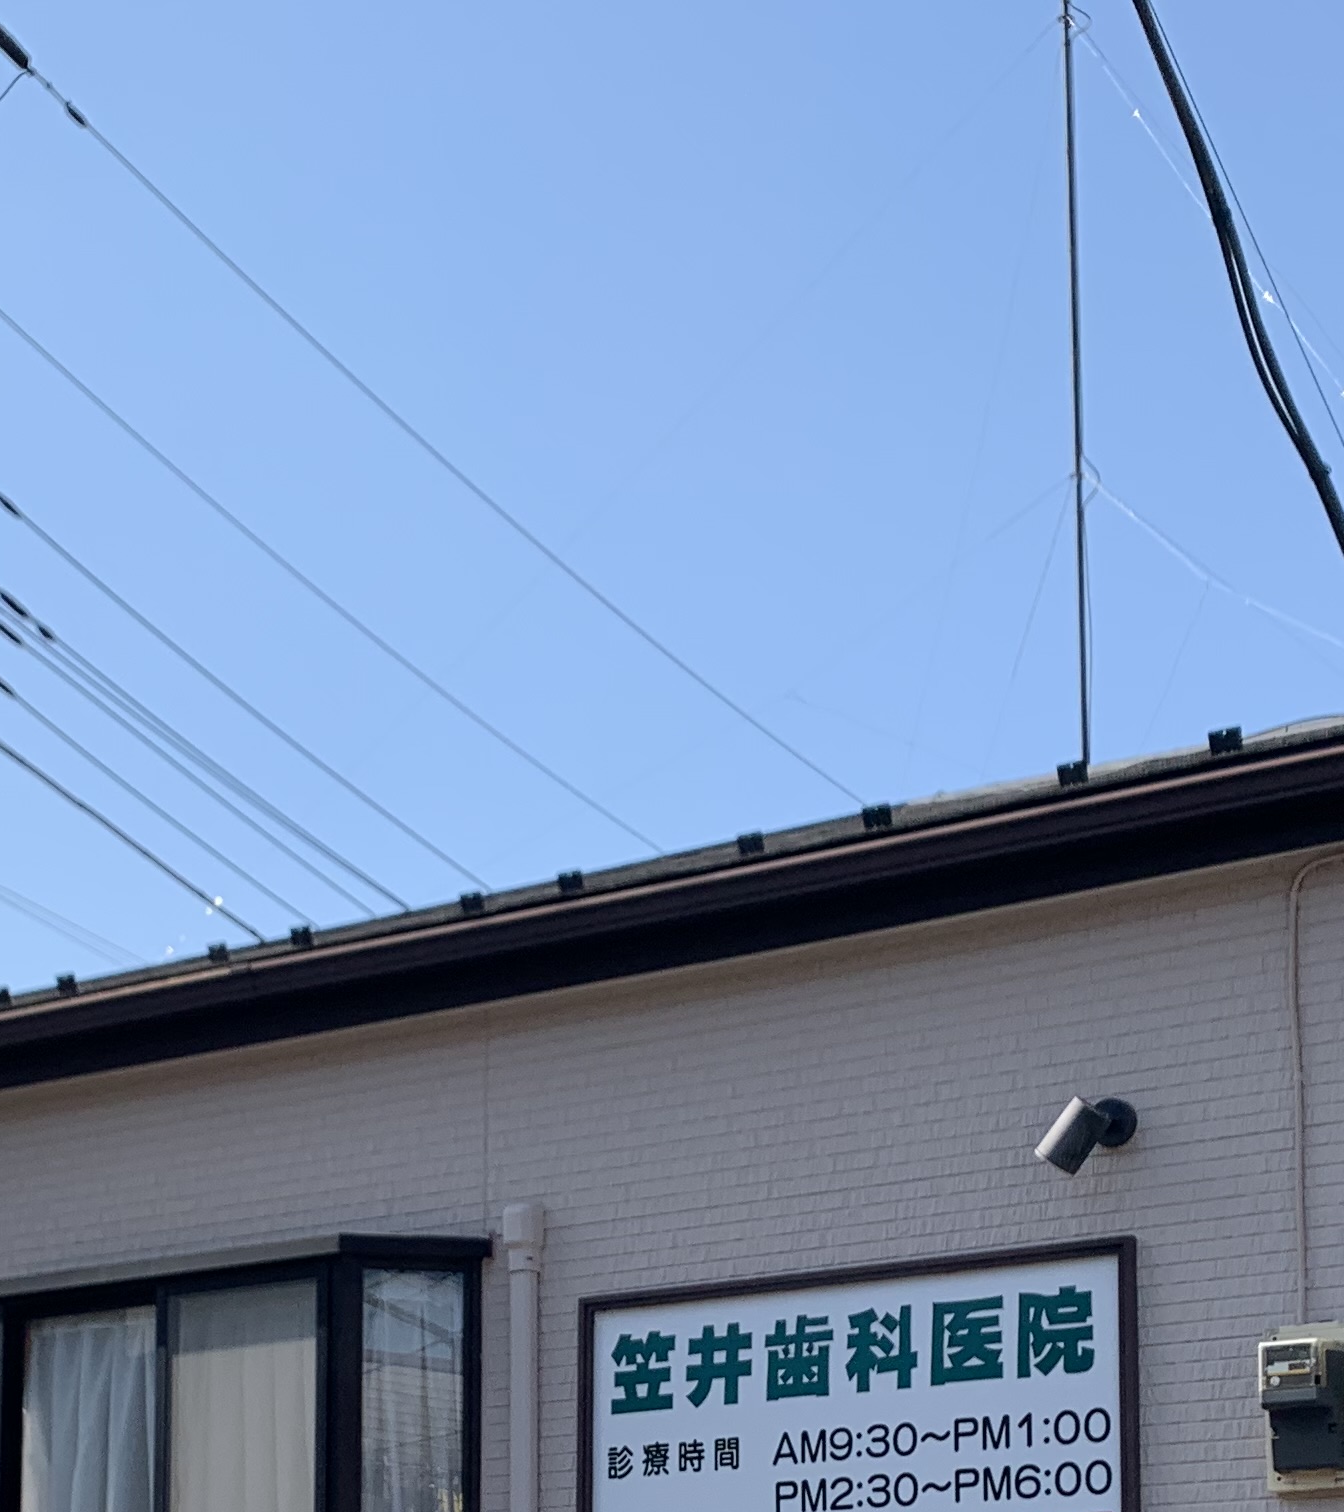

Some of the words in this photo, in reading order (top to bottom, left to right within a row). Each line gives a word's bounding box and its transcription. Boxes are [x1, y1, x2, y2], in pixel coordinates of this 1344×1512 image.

[610, 1285, 1095, 1415] 笠井歯科医院
[606, 1436, 741, 1480] 診療時間
